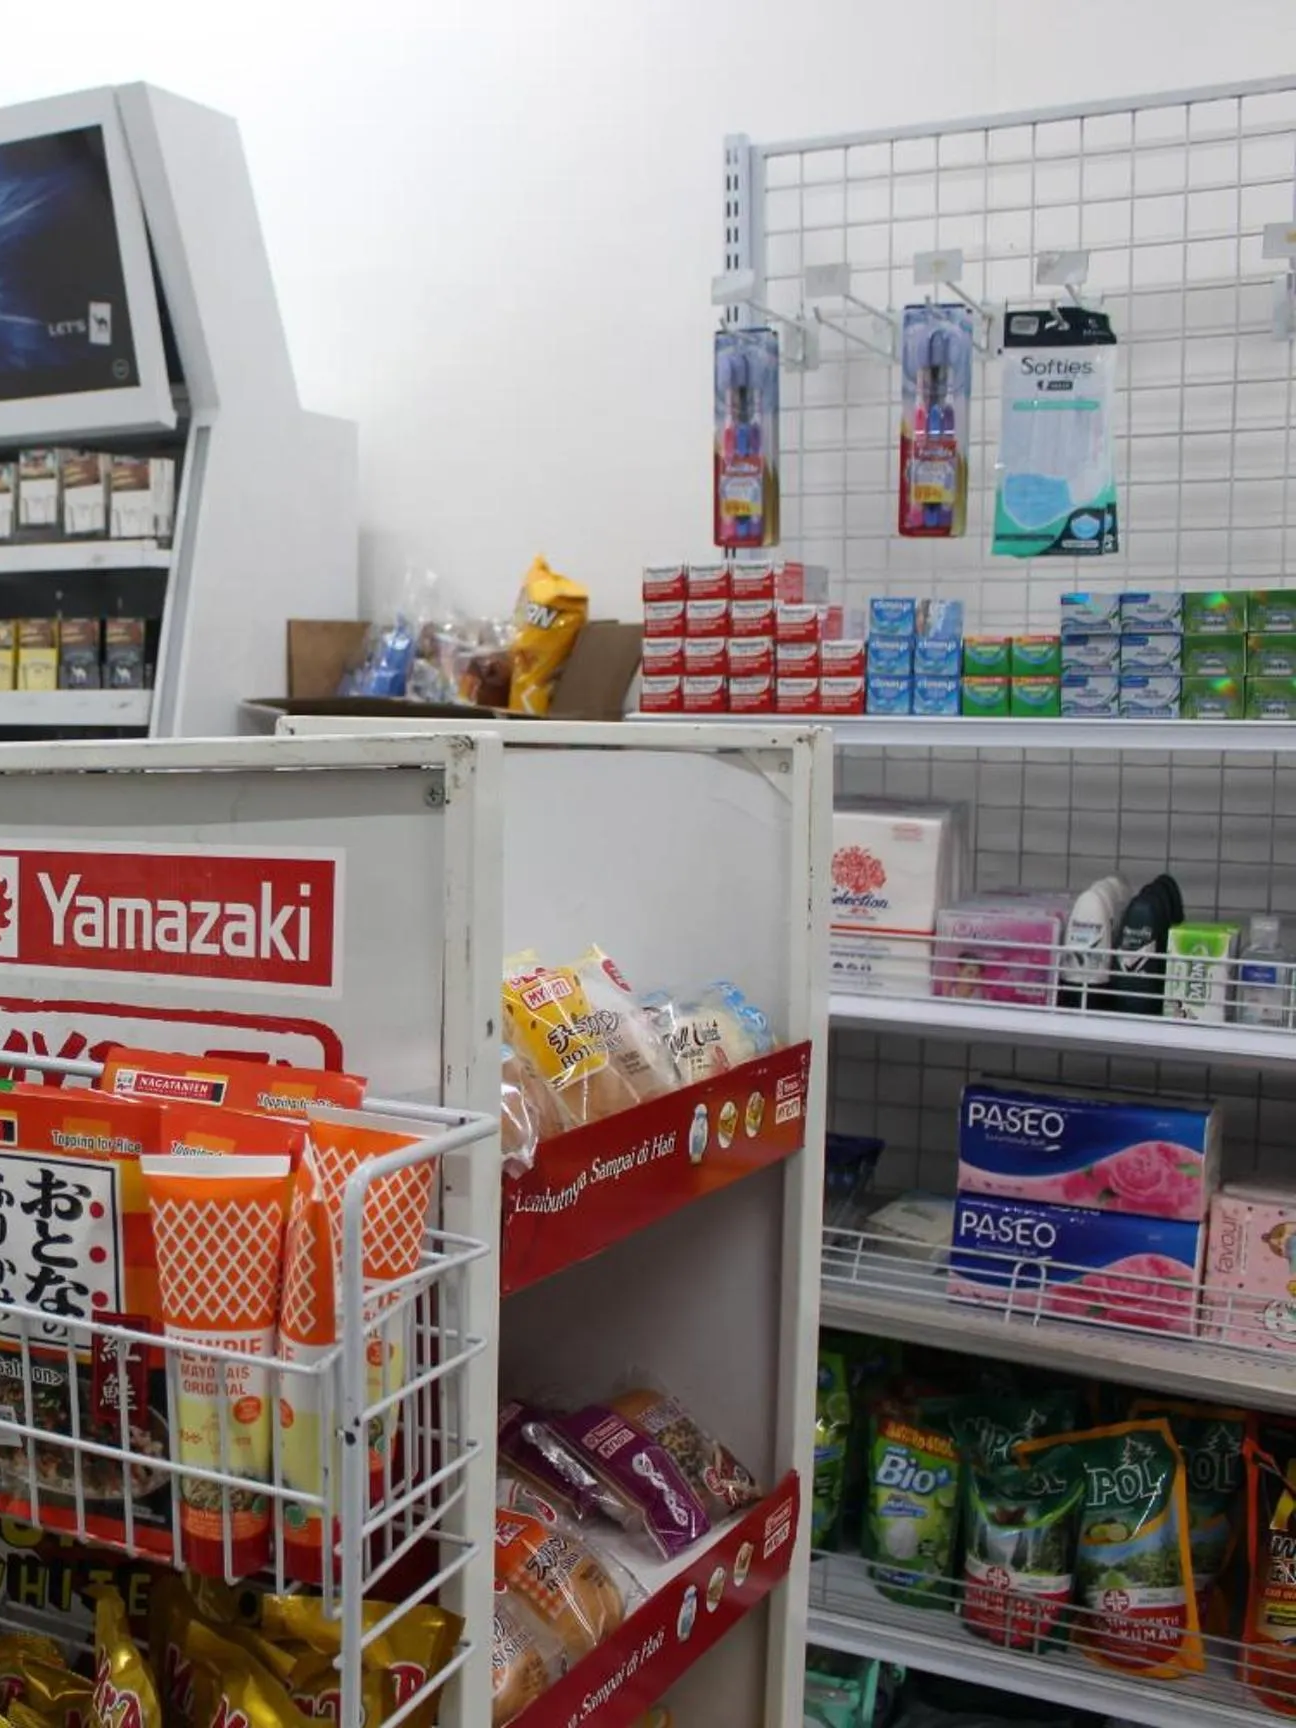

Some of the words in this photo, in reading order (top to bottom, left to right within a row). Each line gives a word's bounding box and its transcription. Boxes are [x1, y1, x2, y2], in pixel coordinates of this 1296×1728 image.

[1020, 356, 1094, 377] Softies
[37, 871, 311, 963] Yamazaki
[140, 1076, 209, 1094] NAGATANIEN
[968, 1102, 1065, 1138] PASEO
[52, 1130, 95, 1151] Topping
[959, 1210, 1057, 1249] PASEO
[180, 1364, 251, 1379] MAYOAIS
